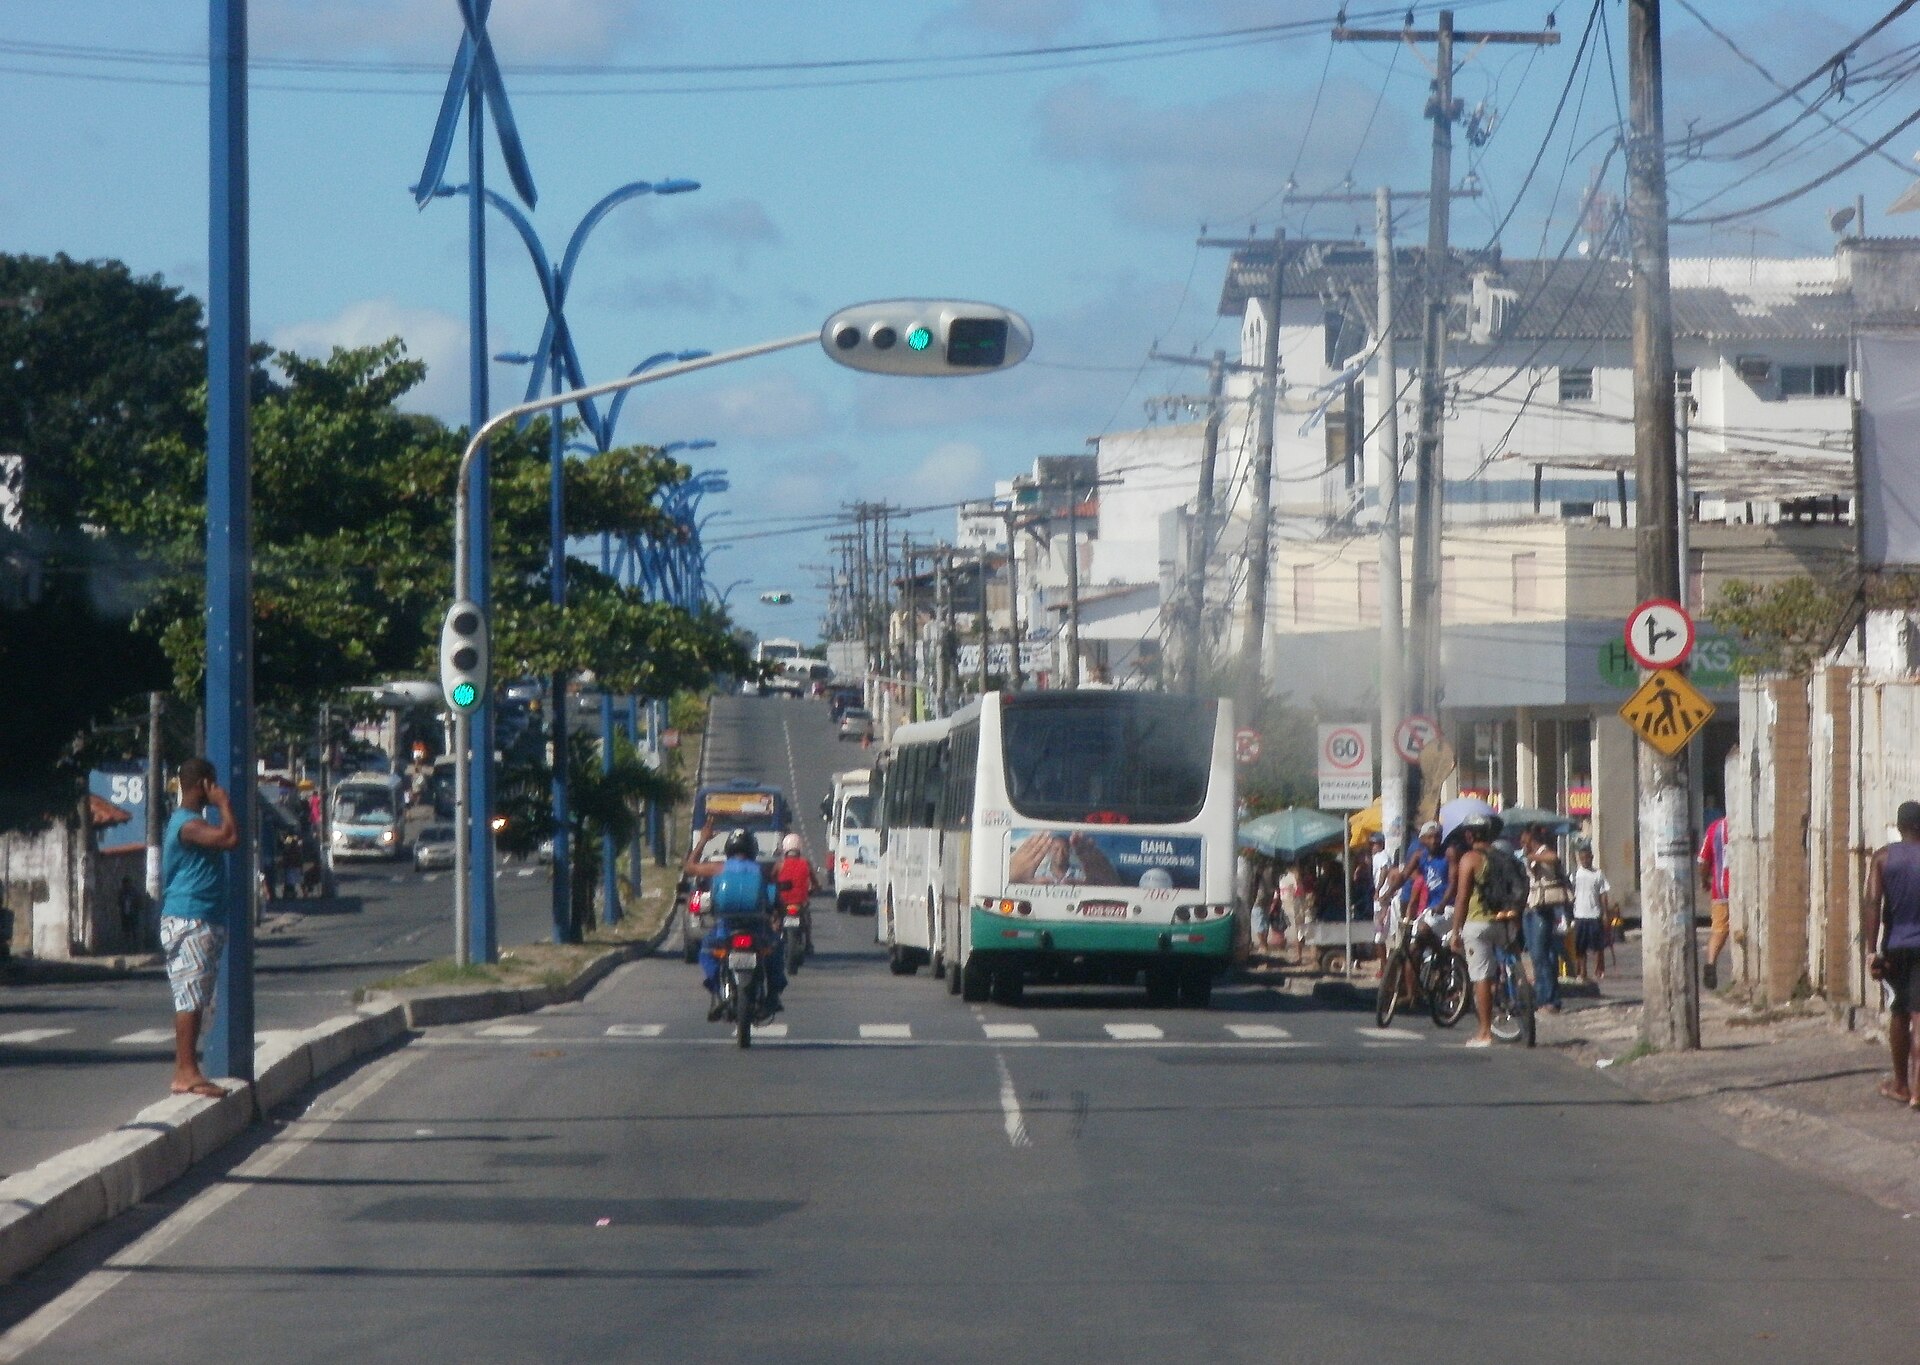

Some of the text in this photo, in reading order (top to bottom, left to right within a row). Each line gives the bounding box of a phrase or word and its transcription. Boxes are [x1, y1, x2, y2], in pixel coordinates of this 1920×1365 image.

[1332, 738, 1359, 758] 60
[110, 775, 143, 804] 58
[1140, 840, 1174, 855] BAHIA
[1119, 853, 1143, 865] TERRA
[1143, 854, 1155, 865] DE
